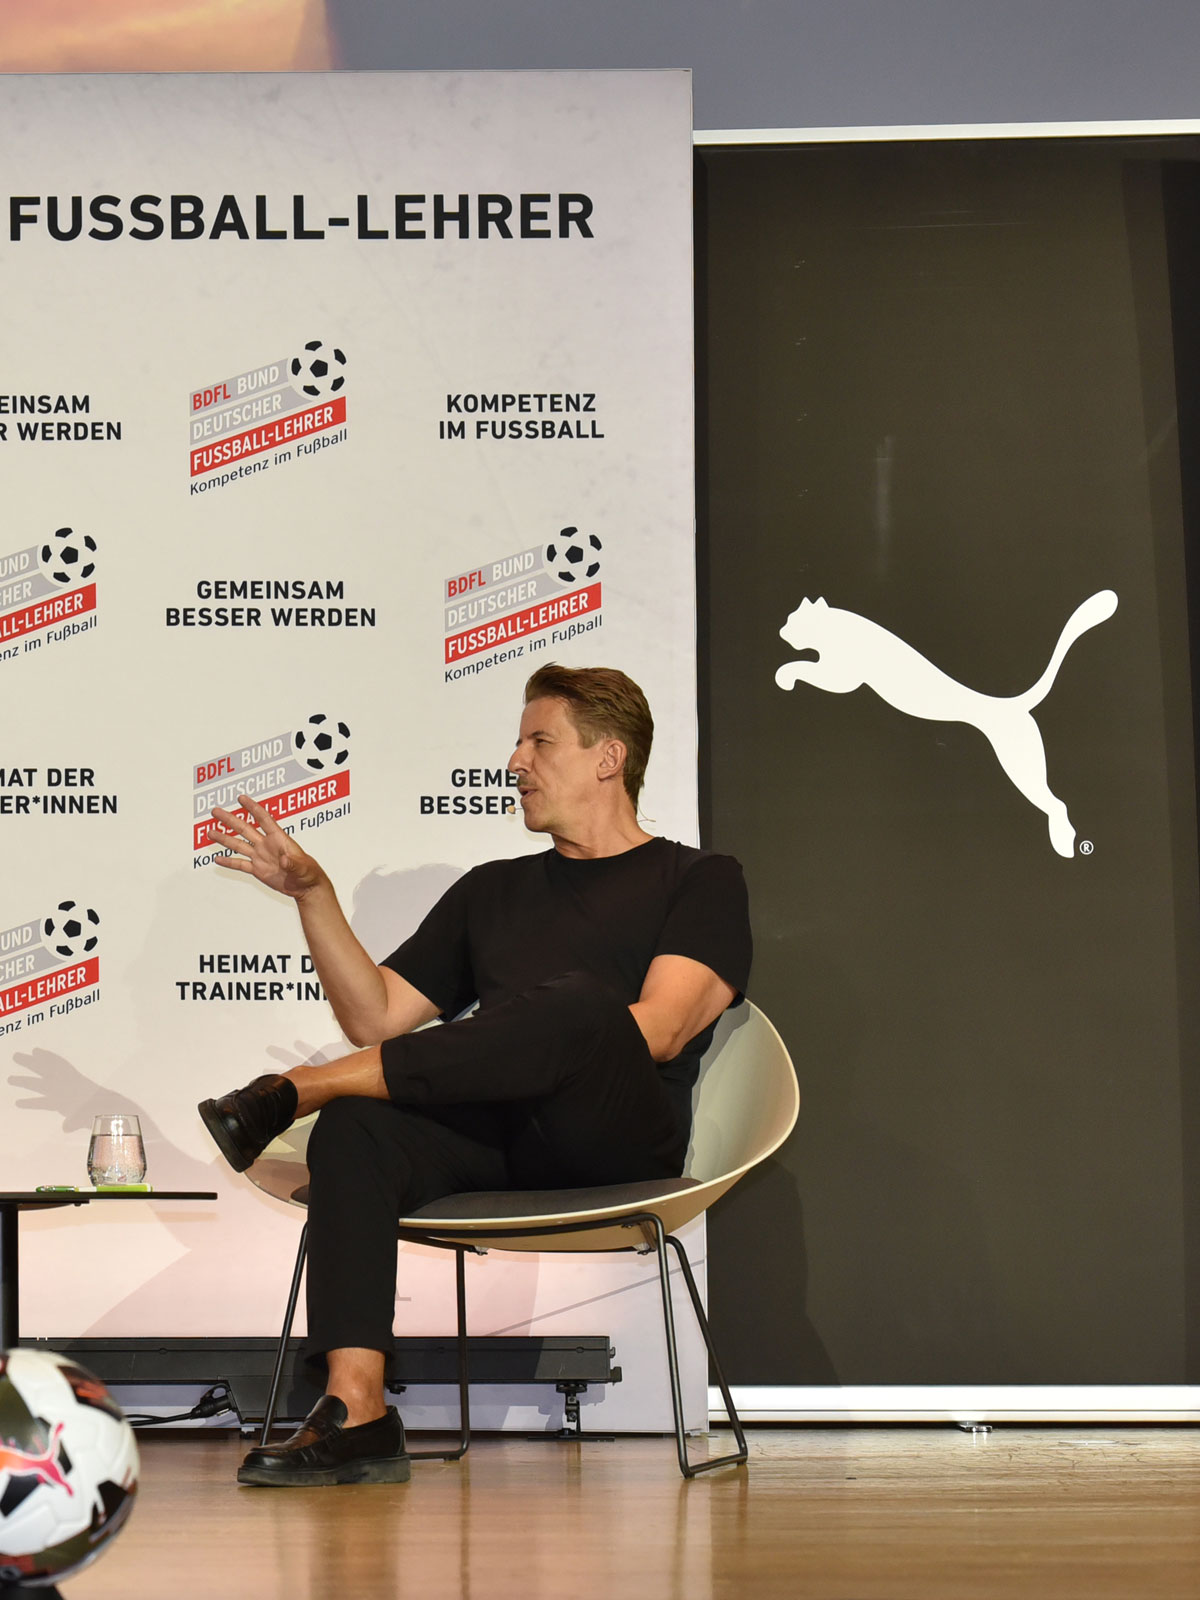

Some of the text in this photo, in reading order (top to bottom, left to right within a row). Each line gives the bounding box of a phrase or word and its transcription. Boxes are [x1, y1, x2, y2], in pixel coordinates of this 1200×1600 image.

[9, 193, 595, 242] FUSSBALL-LEHRER
[194, 365, 280, 412] BDFL BUND
[446, 393, 596, 413] KOMPETENZ
[17, 422, 122, 441] WERDEN
[194, 394, 282, 441] DEUTSCHER
[440, 420, 605, 440] IM FUSSBALL
[194, 406, 334, 472] FUSSBALL-LEHRER
[190, 428, 347, 496] Kompetenz im Fußball
[197, 580, 344, 600] GEMEINSAM
[449, 551, 535, 598] BDFL BUND
[166, 607, 376, 627] BESSER WERDEN
[449, 580, 537, 627] DEUTSCHER
[24, 638, 42, 652] im
[47, 615, 97, 644] Fußball
[449, 592, 589, 658] FUSSBALL-LEHRER
[445, 614, 602, 682] Kompetenz im Fußball
[48, 768, 95, 787] DER
[197, 738, 283, 785] BDFL BUND
[197, 767, 285, 814] DEUTSCHER
[300, 801, 350, 830] Fußball
[199, 954, 292, 974] HEIMAT
[27, 1011, 45, 1025] im
[50, 988, 100, 1017] Fußball
[175, 981, 328, 1001] TRAINERIN
